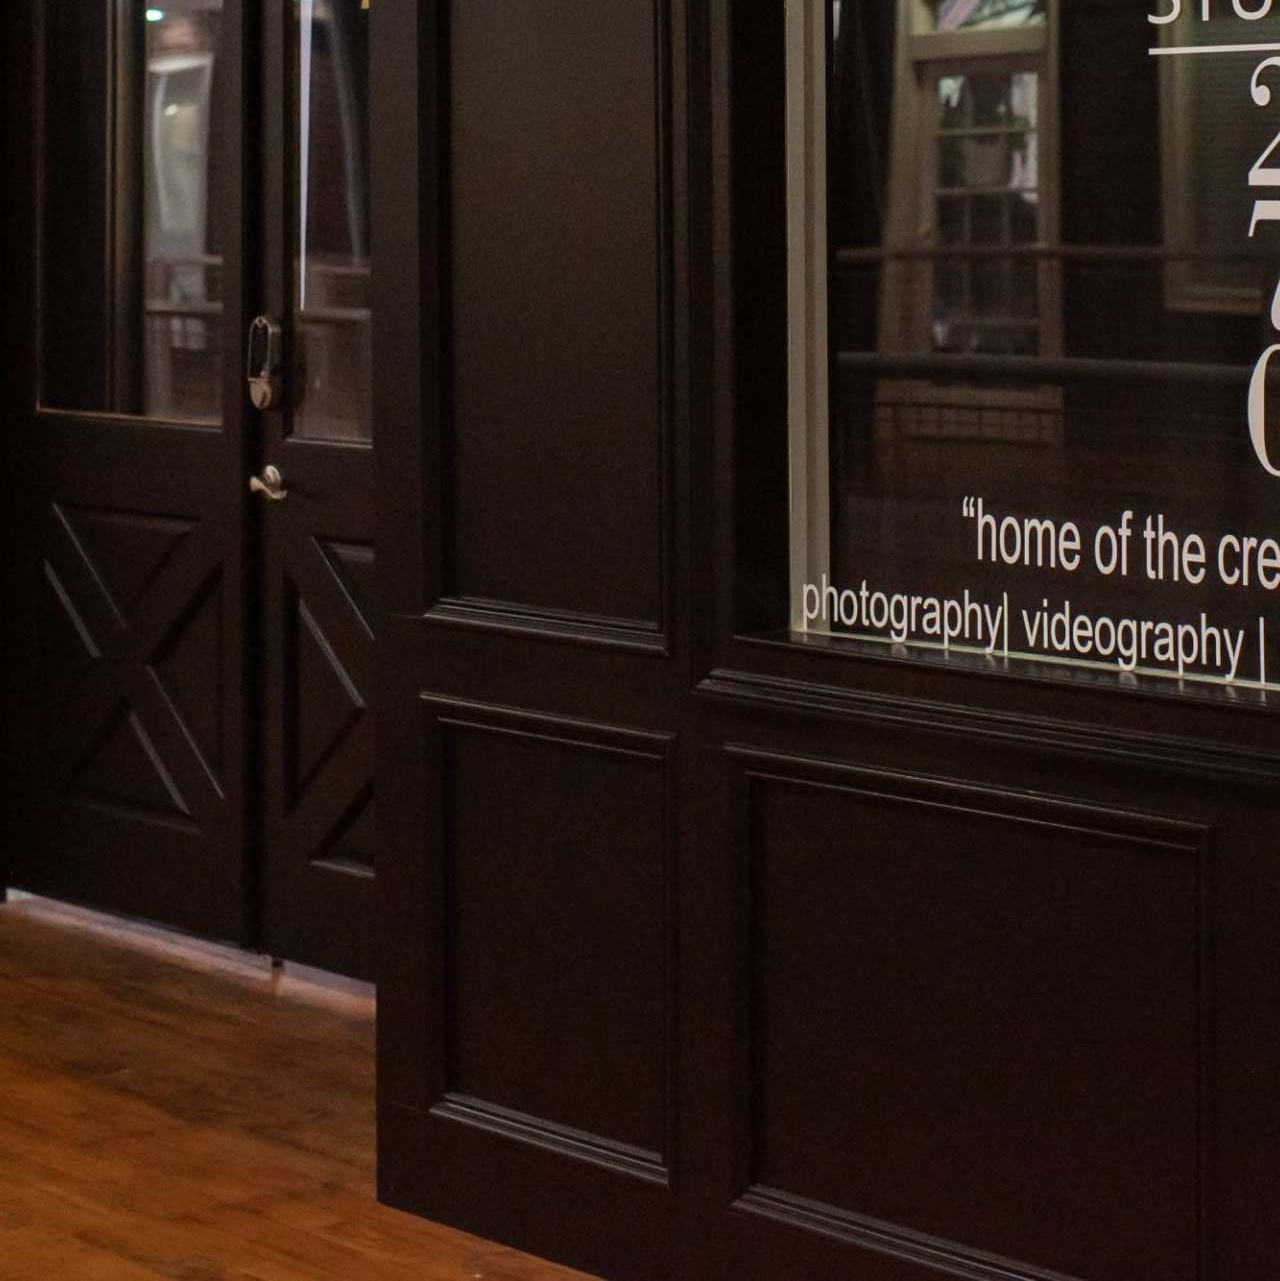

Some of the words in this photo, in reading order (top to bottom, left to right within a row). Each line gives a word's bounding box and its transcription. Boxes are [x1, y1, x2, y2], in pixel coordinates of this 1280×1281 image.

[1094, 510, 1134, 576] of
[1143, 513, 1206, 584] the
[1021, 598, 1245, 682] videography
